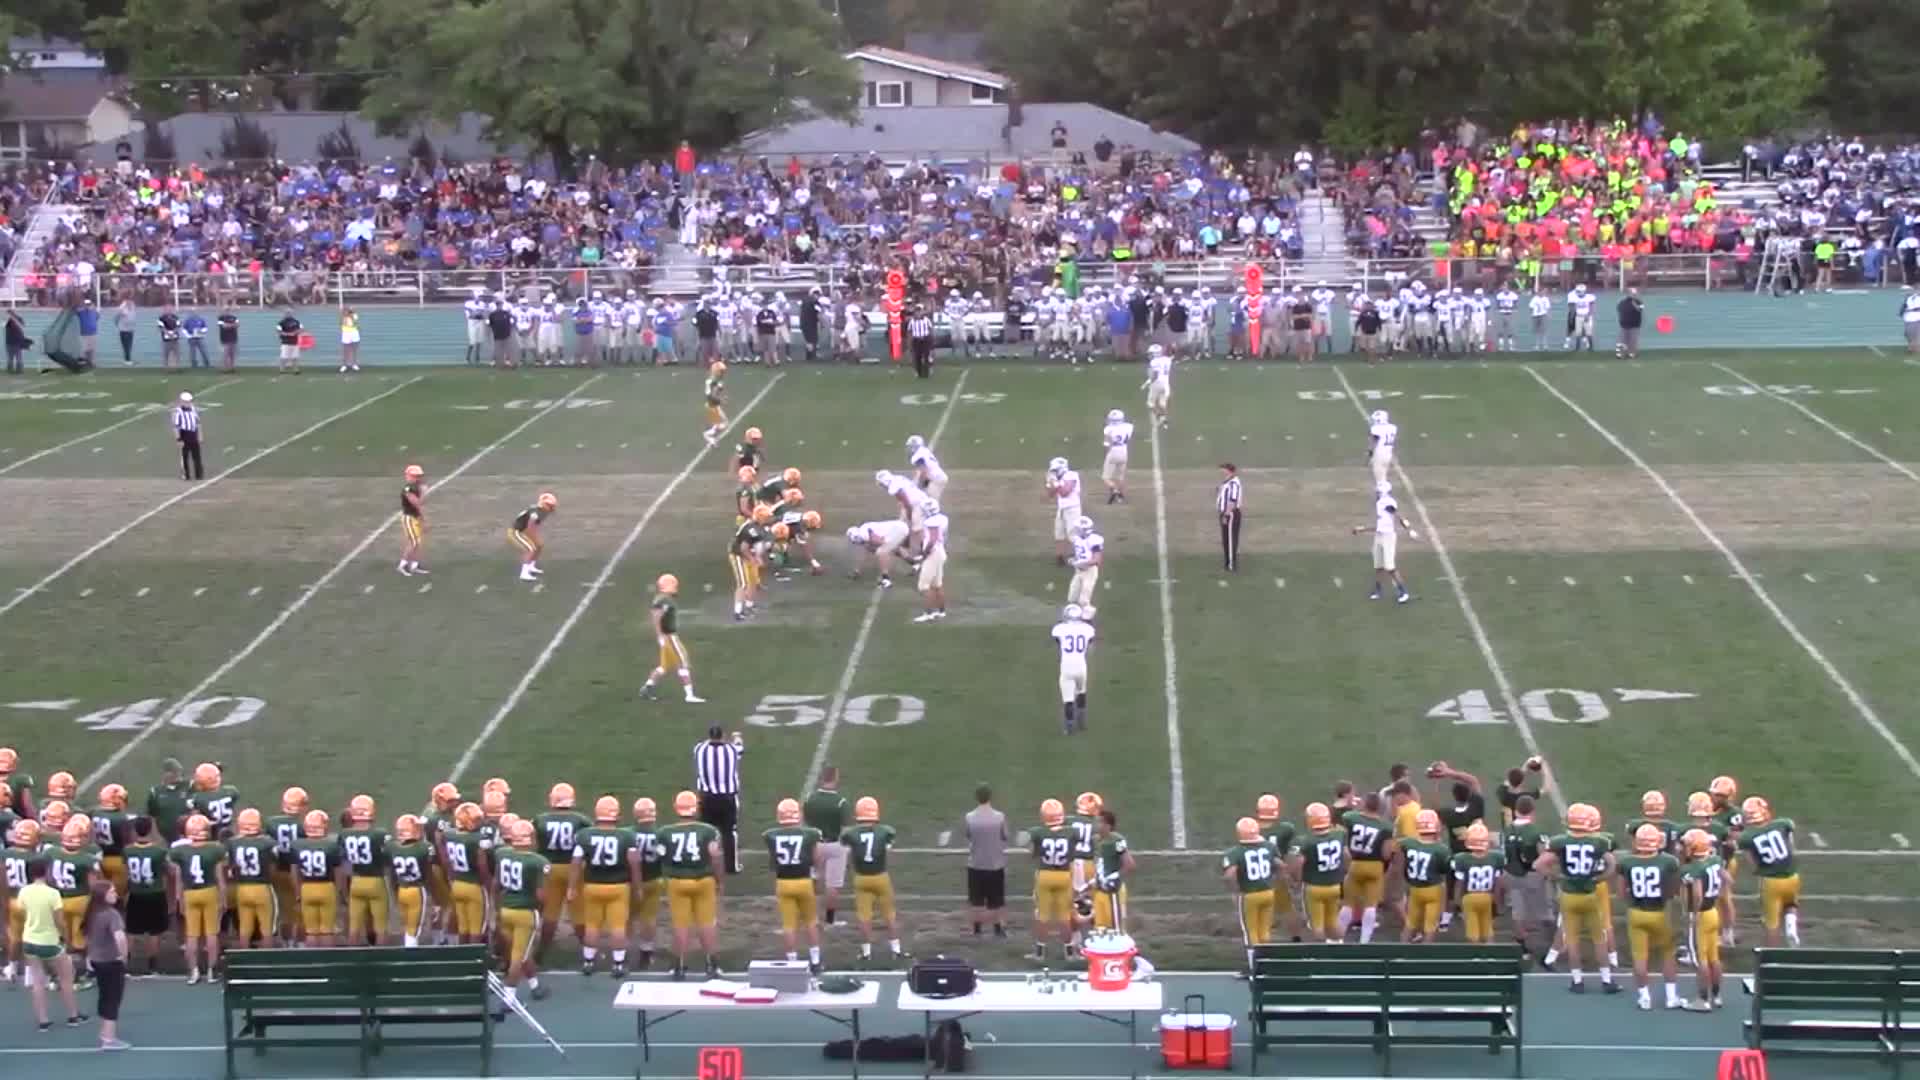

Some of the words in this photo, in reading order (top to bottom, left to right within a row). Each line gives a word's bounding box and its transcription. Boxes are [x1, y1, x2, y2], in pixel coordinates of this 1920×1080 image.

[1064, 634, 1086, 654] 30
[75, 696, 268, 730] 40
[744, 693, 926, 727] 50
[1426, 688, 1610, 725] 40
[345, 835, 373, 865] 83
[546, 821, 574, 851] 78
[590, 835, 619, 867] 79
[671, 831, 701, 863] 74
[775, 835, 804, 865] 57
[860, 832, 875, 863] 7
[1041, 837, 1069, 866] 32
[1350, 824, 1380, 855] 27
[1752, 829, 1789, 864] 50
[127, 856, 154, 885] 84
[189, 854, 205, 884] 4
[236, 846, 261, 876] 43
[299, 849, 327, 878] 39
[393, 856, 421, 882] 23
[1244, 847, 1271, 881] 66
[1316, 840, 1342, 873] 52
[1406, 849, 1432, 881] 37
[1565, 844, 1595, 875] 56
[500, 858, 523, 891] 69
[1631, 866, 1662, 898] 82
[1705, 863, 1722, 898] 15
[1104, 959, 1125, 980] G
[703, 1050, 737, 1080] 50
[1730, 1055, 1761, 1080] 40
